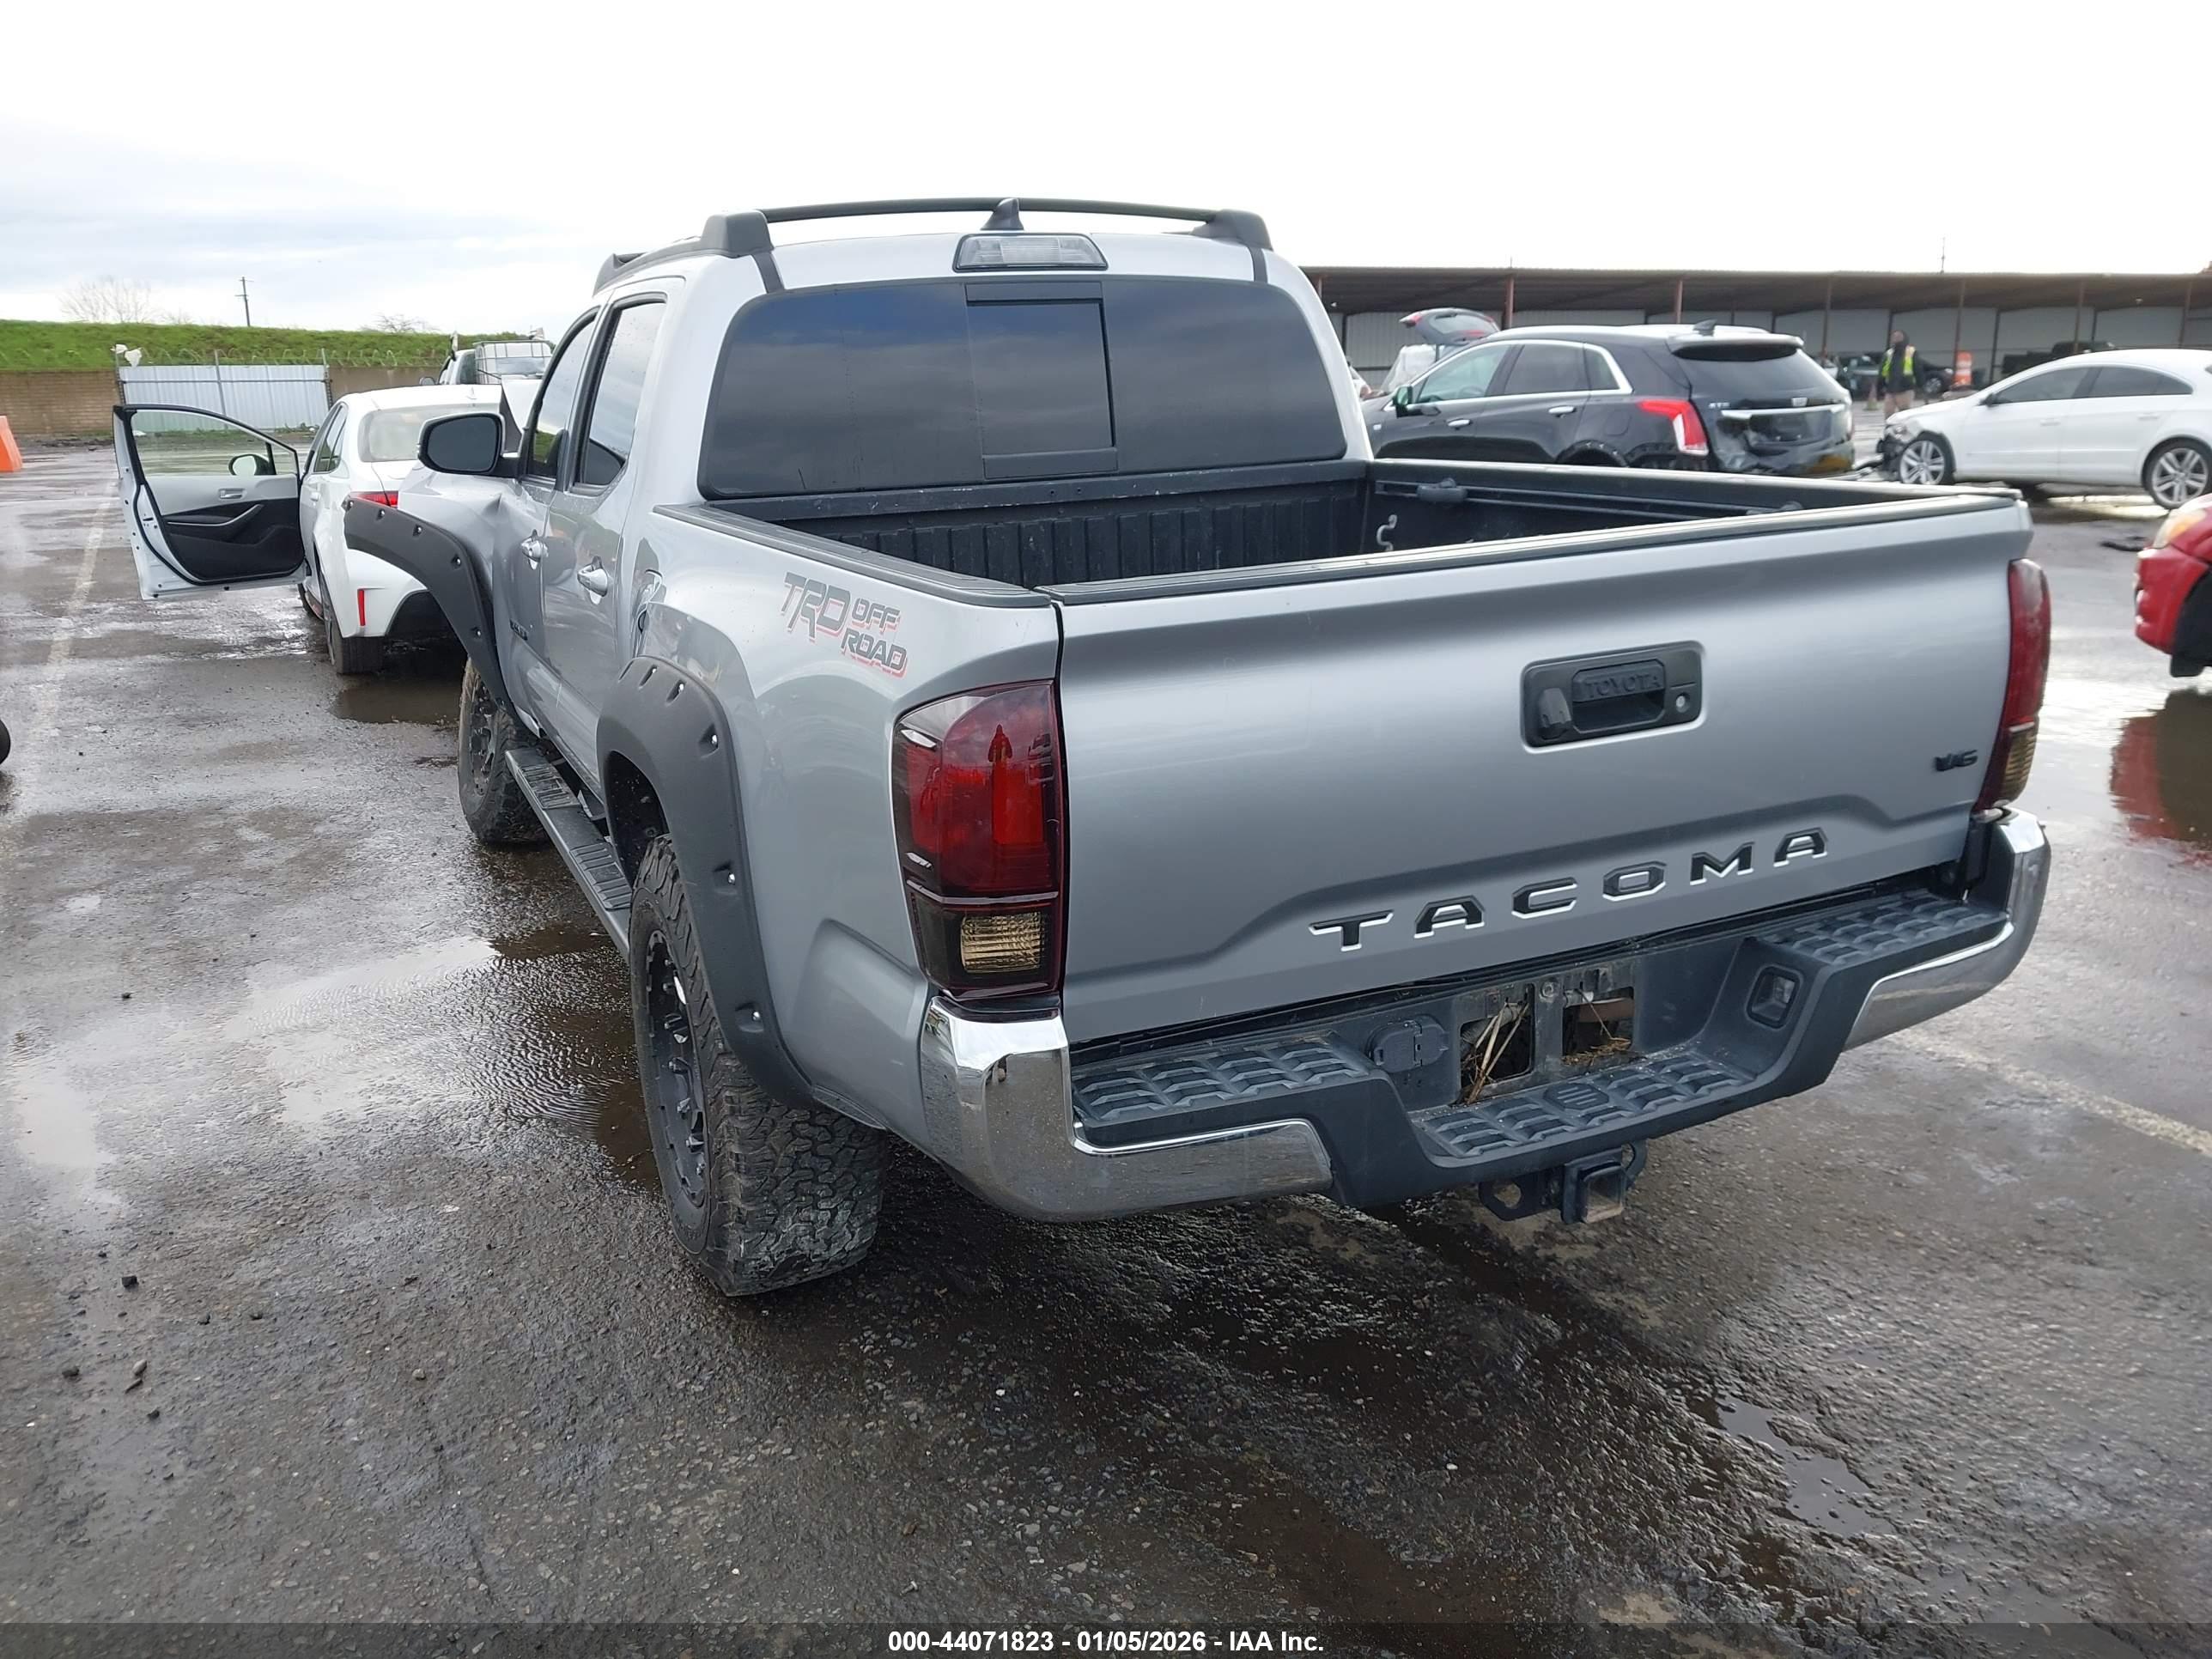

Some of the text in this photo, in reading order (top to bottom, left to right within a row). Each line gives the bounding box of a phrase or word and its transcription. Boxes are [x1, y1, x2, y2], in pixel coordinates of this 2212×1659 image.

[781, 572, 901, 642] TRD OFF
[841, 628, 908, 678] ROAD
[1585, 673, 1662, 700] TOYOTA
[1308, 826, 1829, 952] TACOMA
